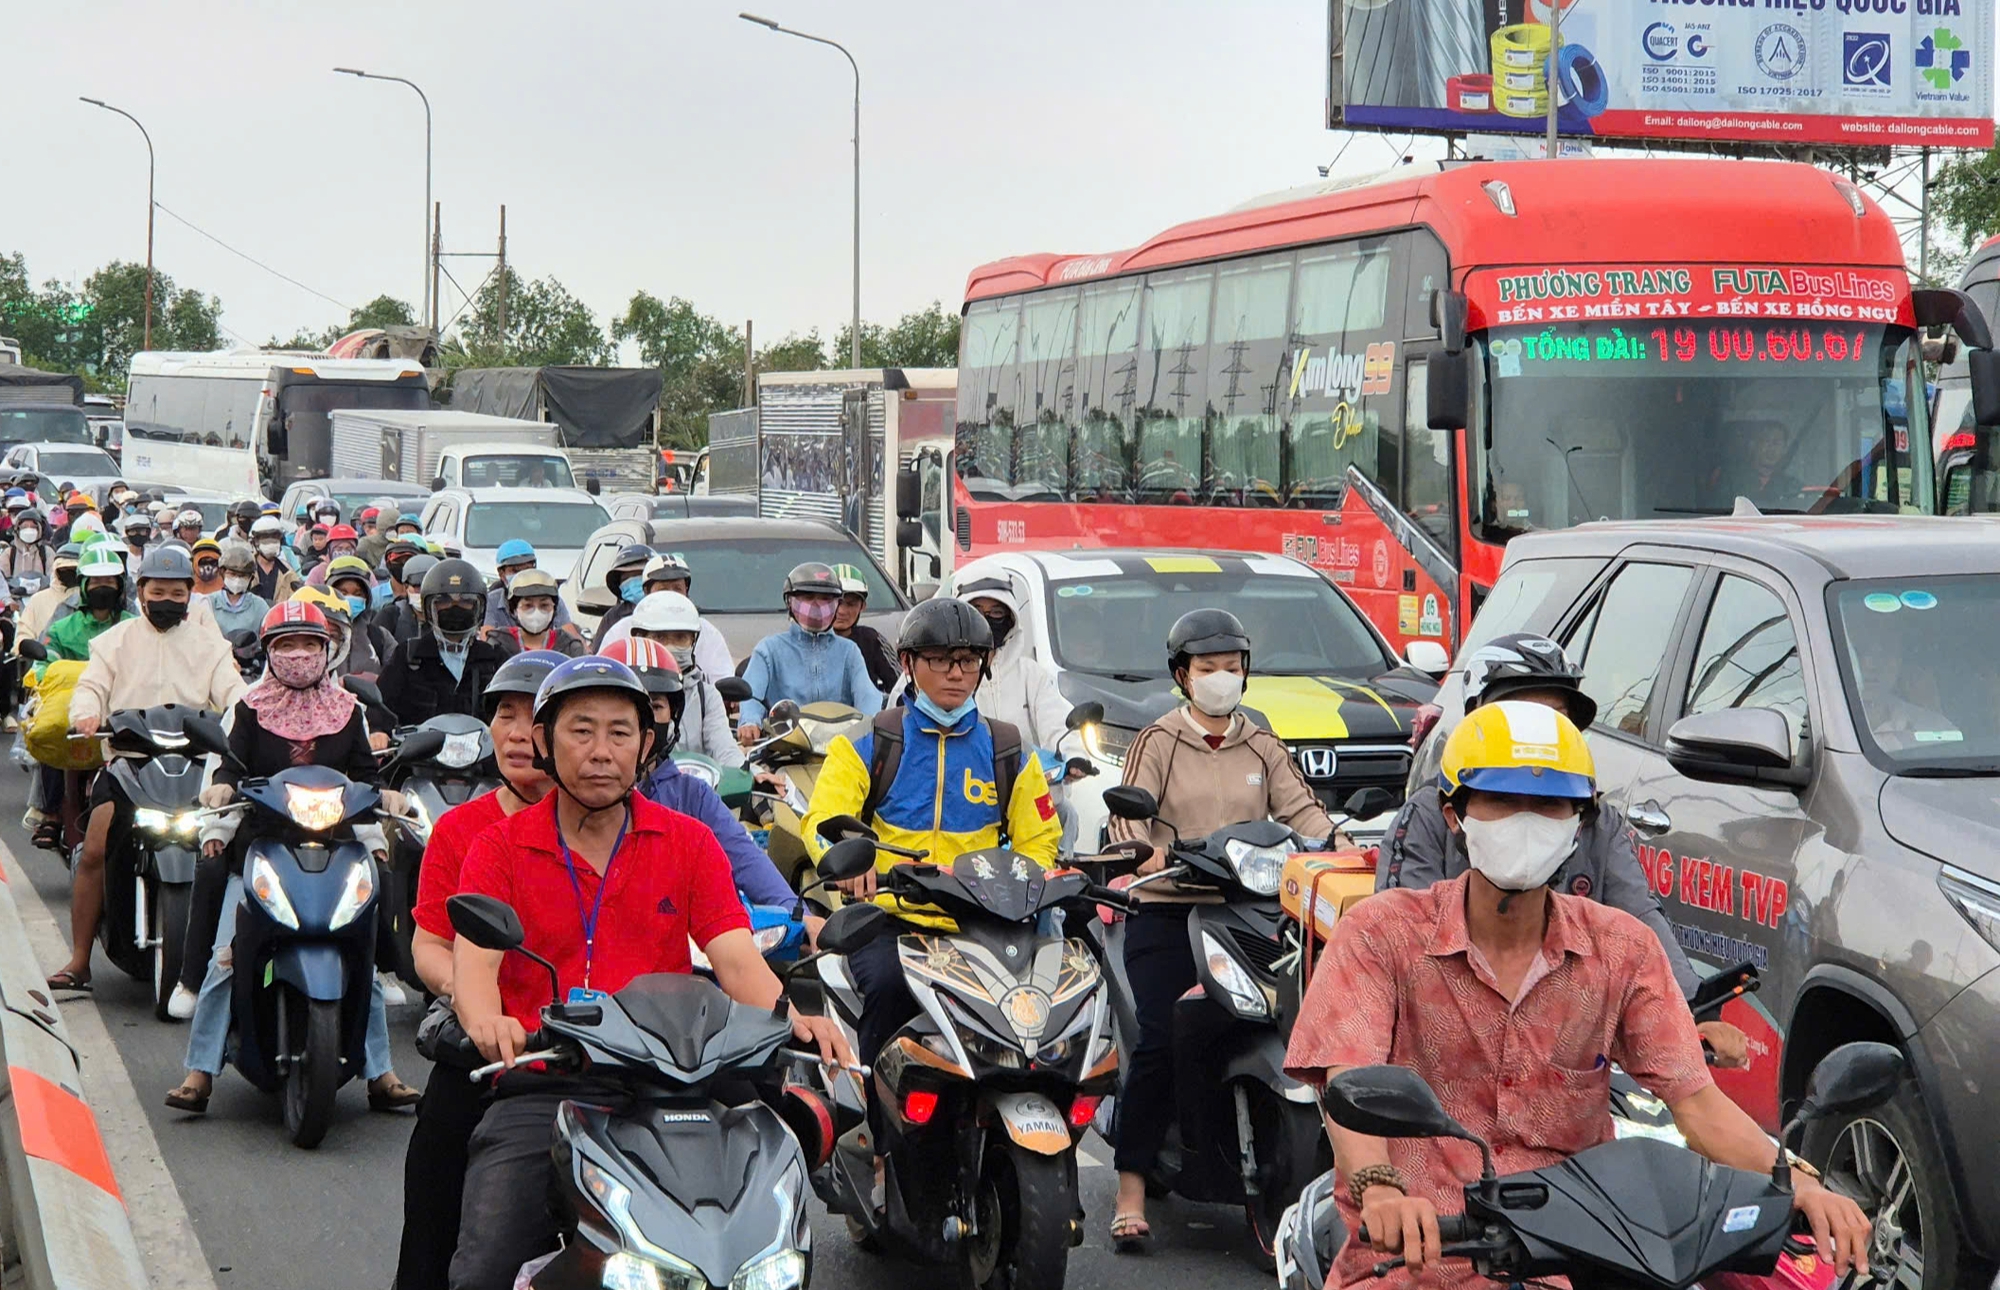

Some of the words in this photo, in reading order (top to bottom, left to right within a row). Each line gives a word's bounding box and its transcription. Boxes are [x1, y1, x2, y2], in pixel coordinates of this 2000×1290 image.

[1649, 36, 1678, 47] QUACERT
[1642, 67, 1659, 75] ISO
[1665, 68, 1716, 77] 9001:2015
[1642, 76, 1659, 84] ISO
[1661, 77, 1716, 85] 14001:2015
[1642, 85, 1659, 93] ISO
[1661, 86, 1716, 94] 45001:2018
[1738, 86, 1757, 95] ISO
[1760, 87, 1823, 97] 17025:2017
[1916, 91, 1948, 101] Vietnam
[1645, 115, 1674, 127] Email:
[1841, 122, 1885, 133] website:
[1498, 268, 1602, 302] PHƯƠNG
[1605, 268, 1692, 297] TRANG
[1713, 269, 1788, 295] FUTA
[1498, 303, 1543, 323] BẾN
[1550, 306, 1580, 320] XE
[1585, 297, 1641, 318] MIỀN
[1646, 299, 1692, 316] TÂY
[1716, 296, 1759, 315] BẾN
[1764, 302, 1792, 315] XE
[1796, 297, 1853, 317] HỒNG
[1858, 306, 1898, 323] NGỰ
[1652, 327, 1697, 361] 19
[1425, 599, 1435, 615] 05
[519, 658, 556, 667] HONDA
[1740, 869, 1788, 929] TVP
[1754, 943, 1769, 972] GIA
[663, 1113, 711, 1122] HONDA
[1017, 1121, 1067, 1136] YAMAHA
